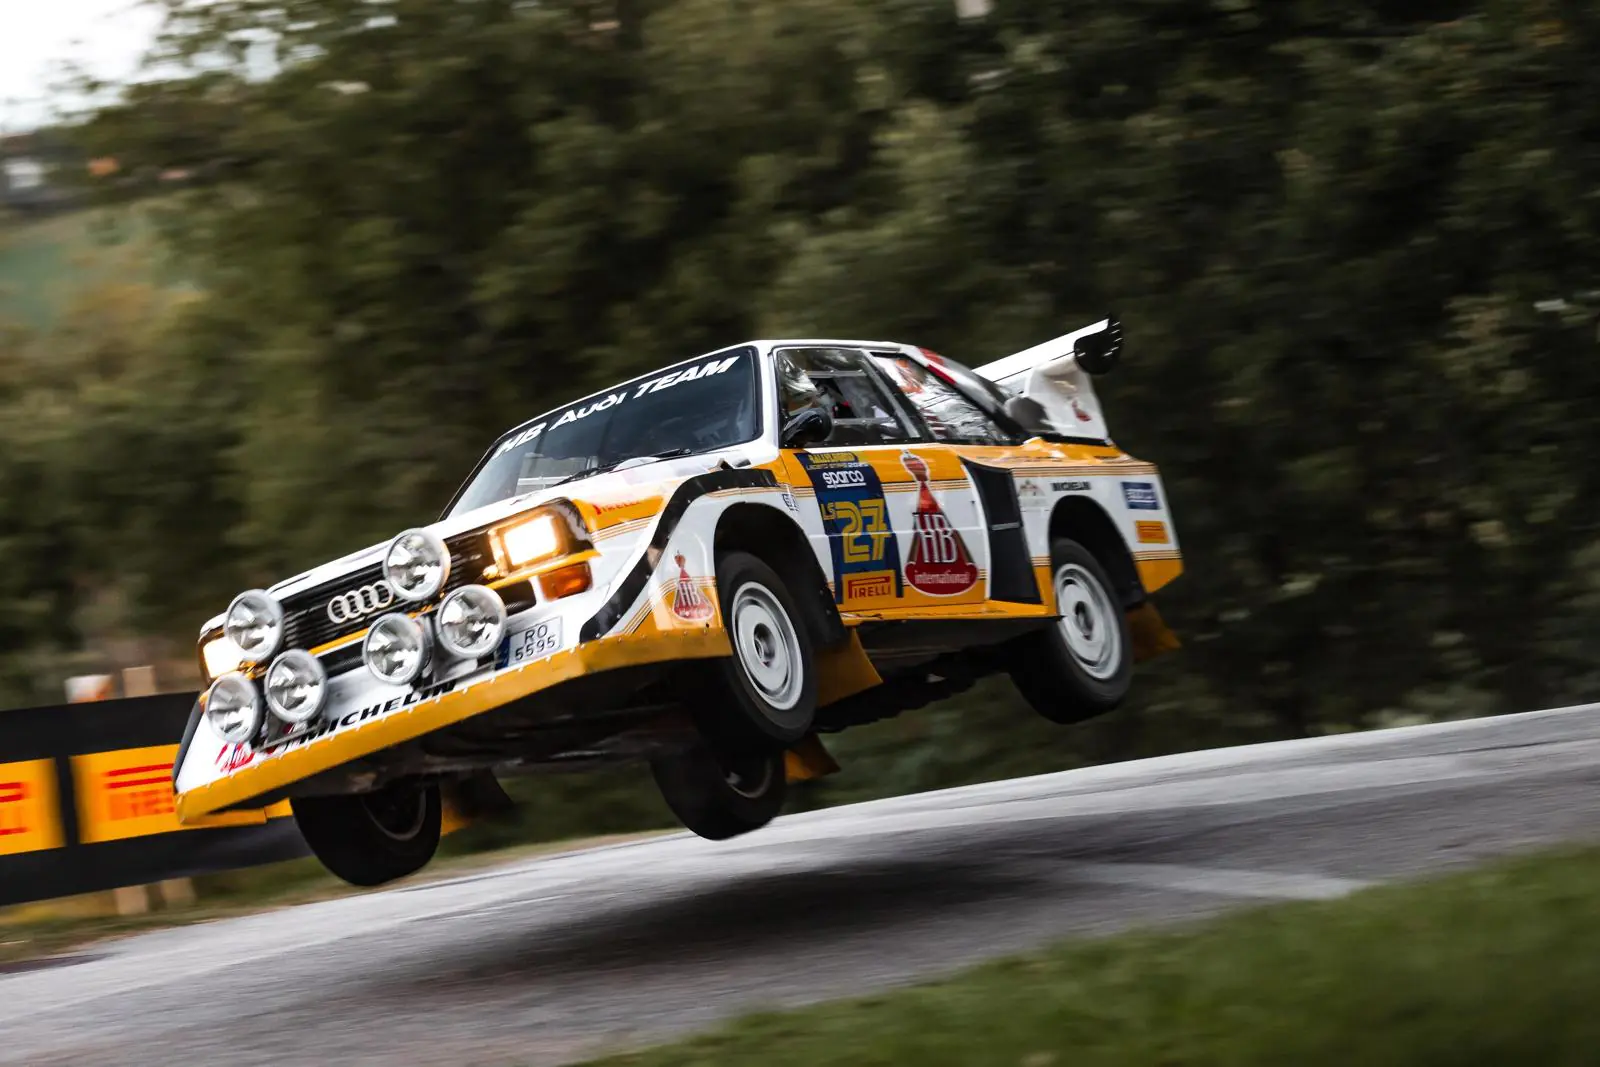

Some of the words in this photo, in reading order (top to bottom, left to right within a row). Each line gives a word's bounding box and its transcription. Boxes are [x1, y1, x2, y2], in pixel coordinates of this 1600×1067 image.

[494, 421, 547, 460] HB
[633, 356, 740, 399] TEAM
[822, 470, 865, 487] sparco
[835, 498, 892, 563] 27
[913, 512, 958, 563] HB
[848, 576, 891, 599] PIRELLI
[914, 570, 971, 585] international
[679, 581, 701, 608] HB
[514, 635, 557, 661] 5595
[523, 624, 549, 646] RO
